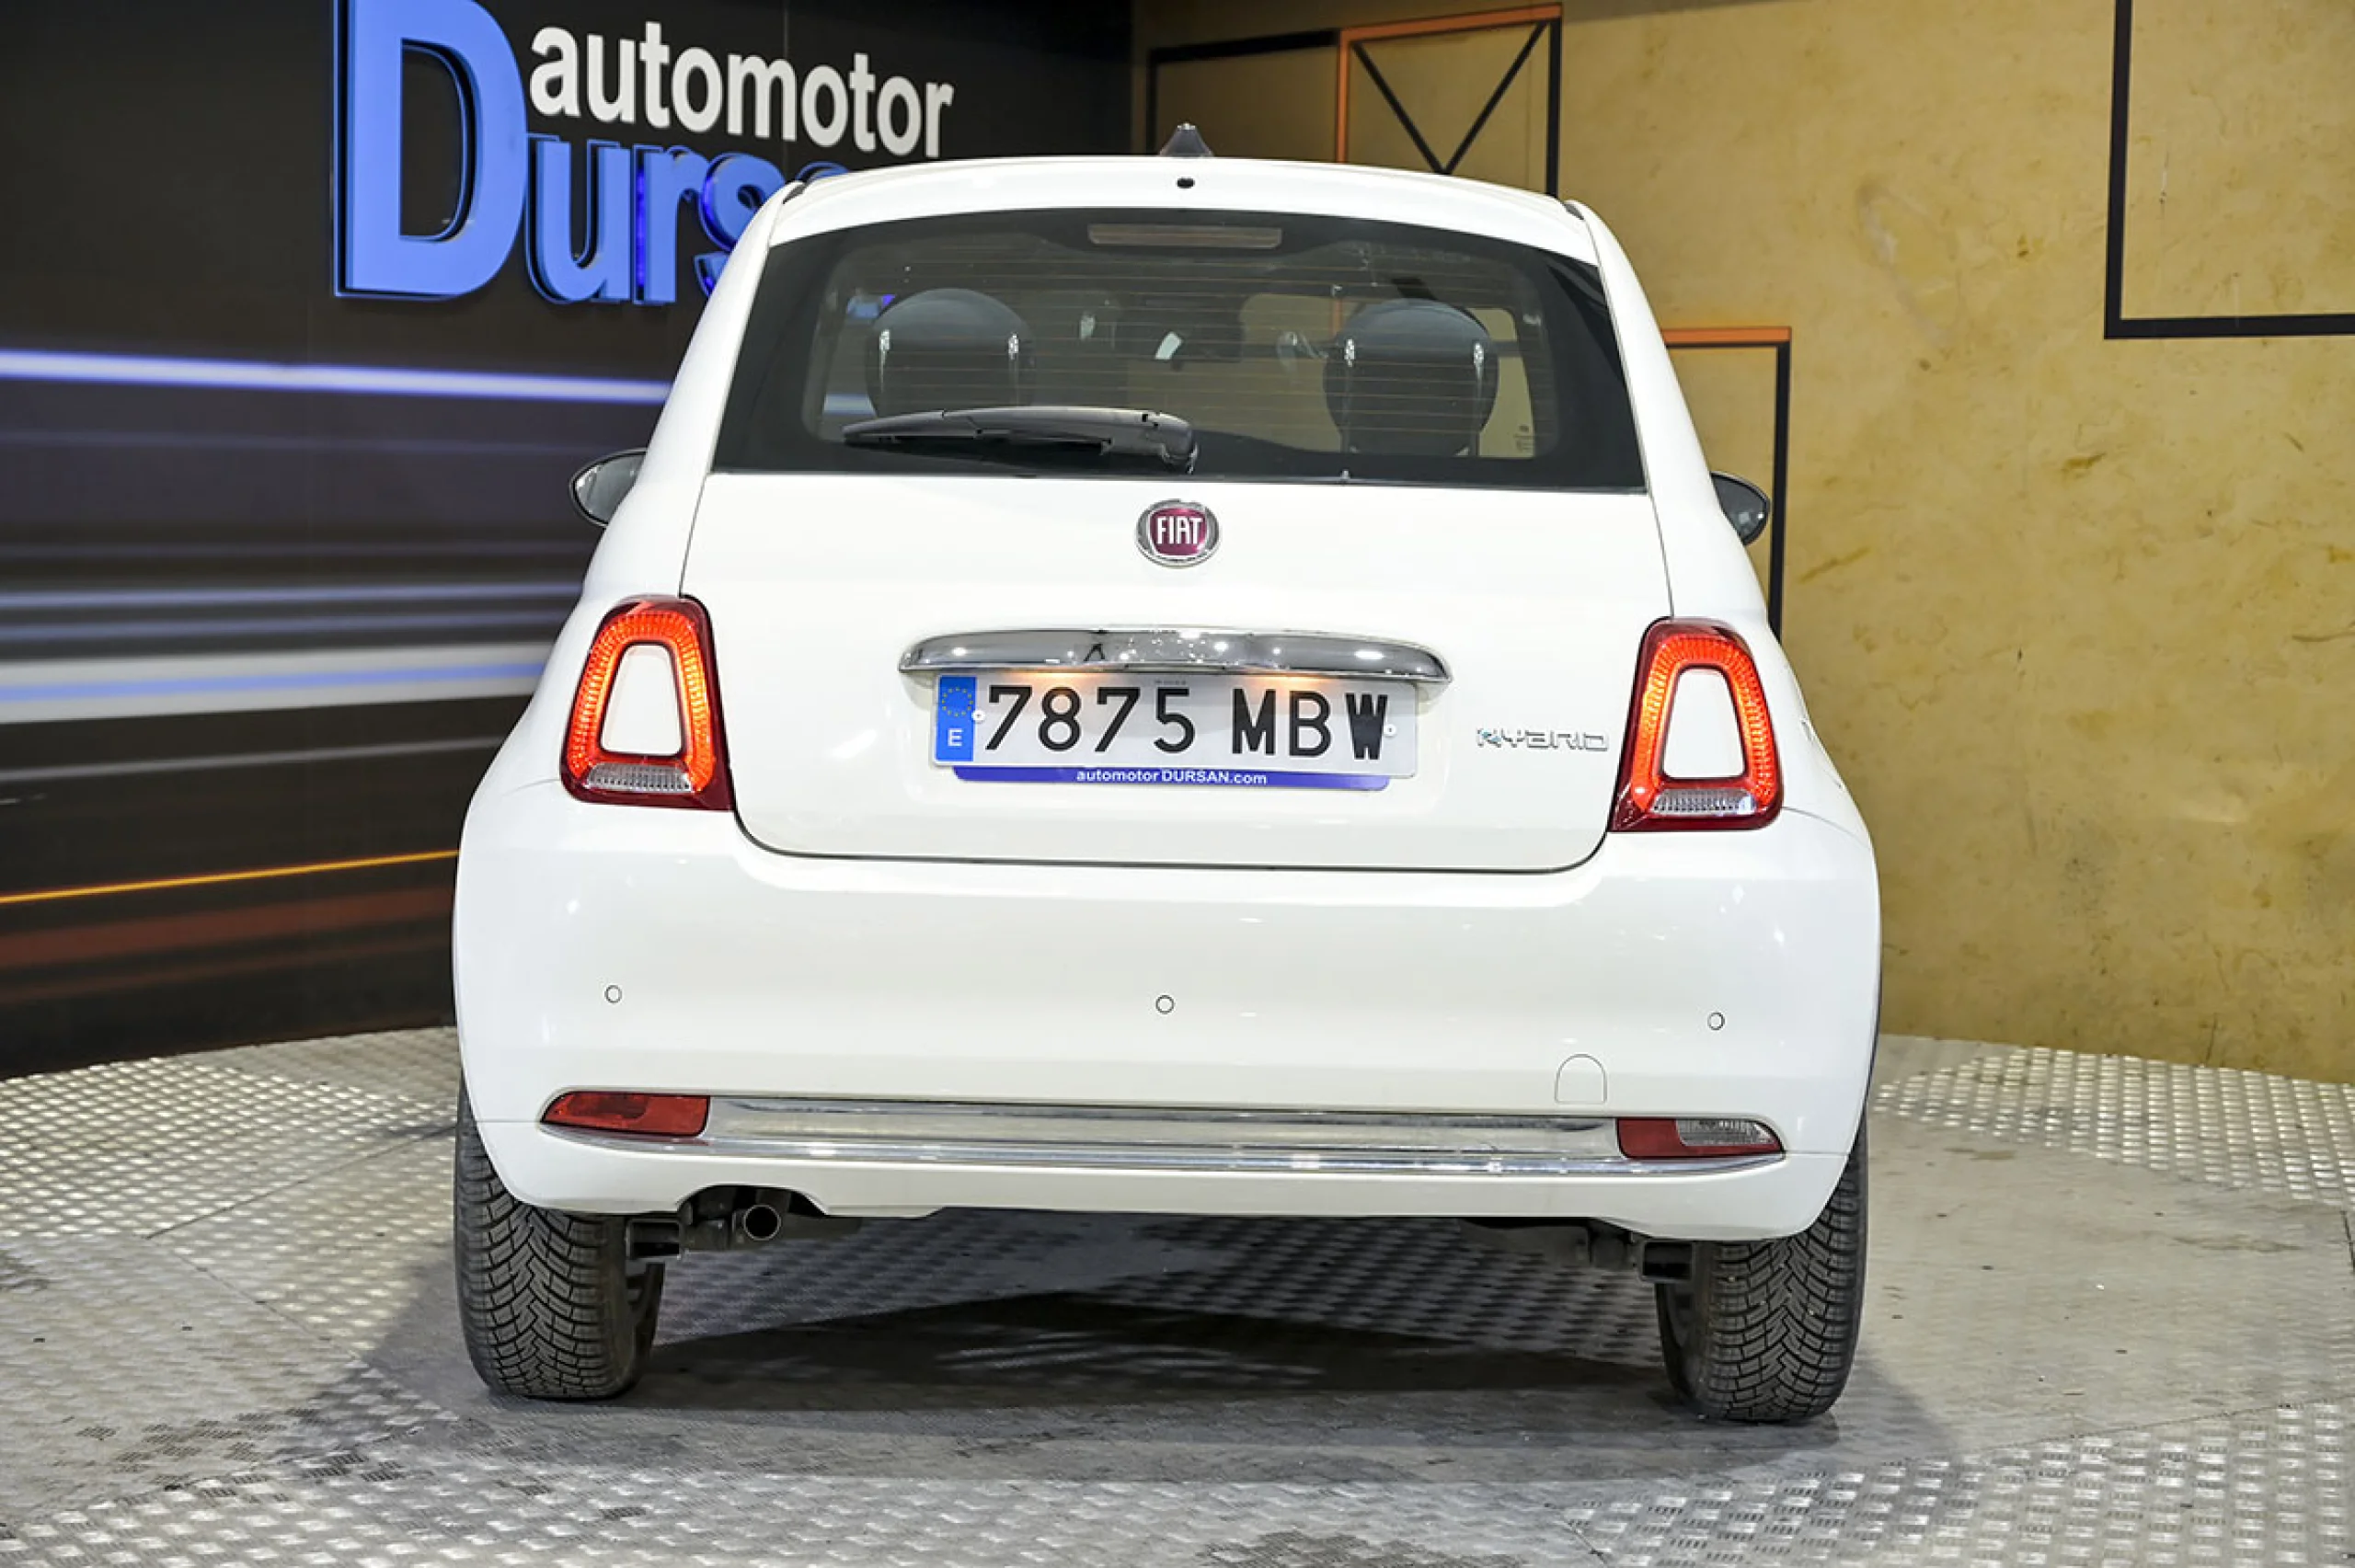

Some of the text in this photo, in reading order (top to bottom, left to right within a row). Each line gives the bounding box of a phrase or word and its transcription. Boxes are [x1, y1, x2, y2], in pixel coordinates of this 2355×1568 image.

[531, 21, 955, 158] automotor
[335, 0, 849, 305] Durs
[1156, 515, 1203, 544] FIAT
[947, 727, 963, 747] E
[985, 685, 1389, 761] 7875 MBW
[1476, 727, 1609, 752] HYBRID
